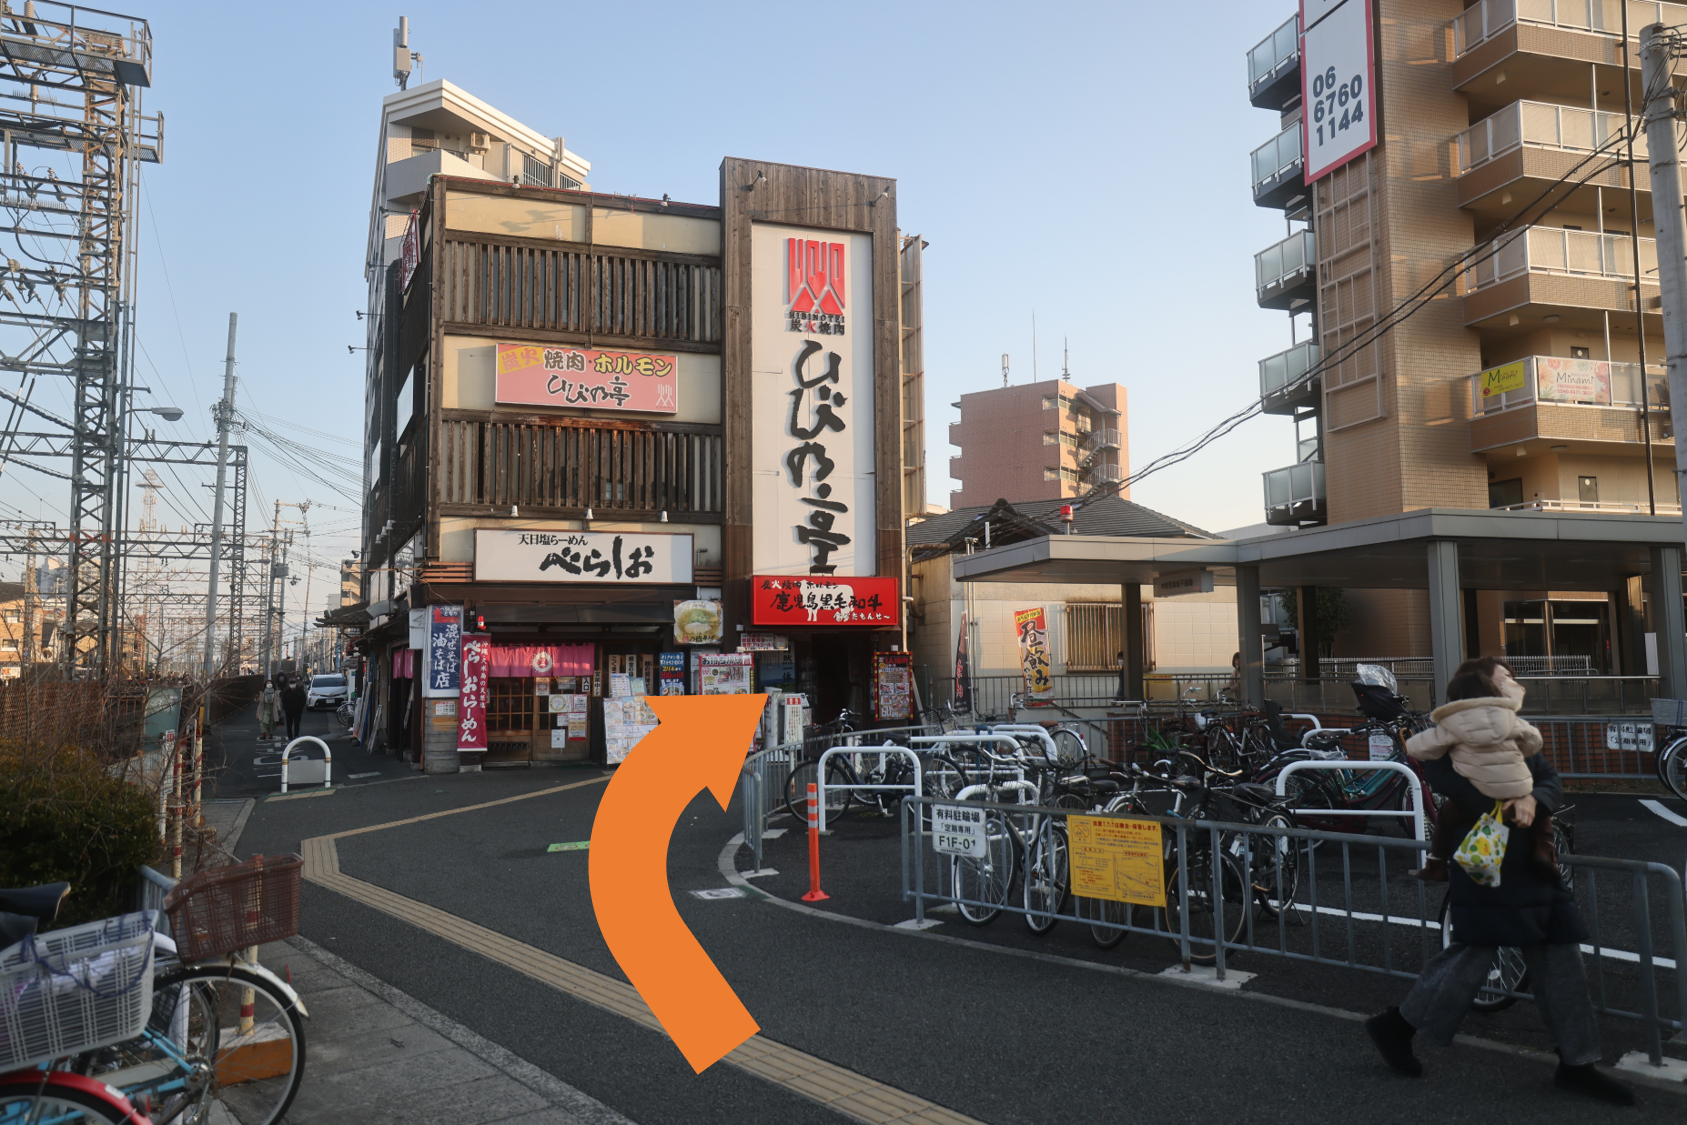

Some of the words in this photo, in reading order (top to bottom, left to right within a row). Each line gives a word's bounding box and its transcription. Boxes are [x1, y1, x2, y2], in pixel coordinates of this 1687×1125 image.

[1312, 66, 1336, 98] 06
[1313, 74, 1362, 123] 6760
[1316, 99, 1364, 147] 1144
[789, 311, 845, 322] HIBINOTEI
[790, 320, 845, 335] 炭火焼肉
[501, 347, 541, 372] 炭火
[1556, 372, 1594, 385] Minami
[518, 533, 588, 546] 天日塩らーめん
[432, 633, 450, 689] 油そば店
[446, 624, 460, 673] 混ぜそば
[1020, 620, 1049, 686] 昼飲み
[583, 678, 590, 691] 入口
[936, 808, 980, 823] 有料駐輪場
